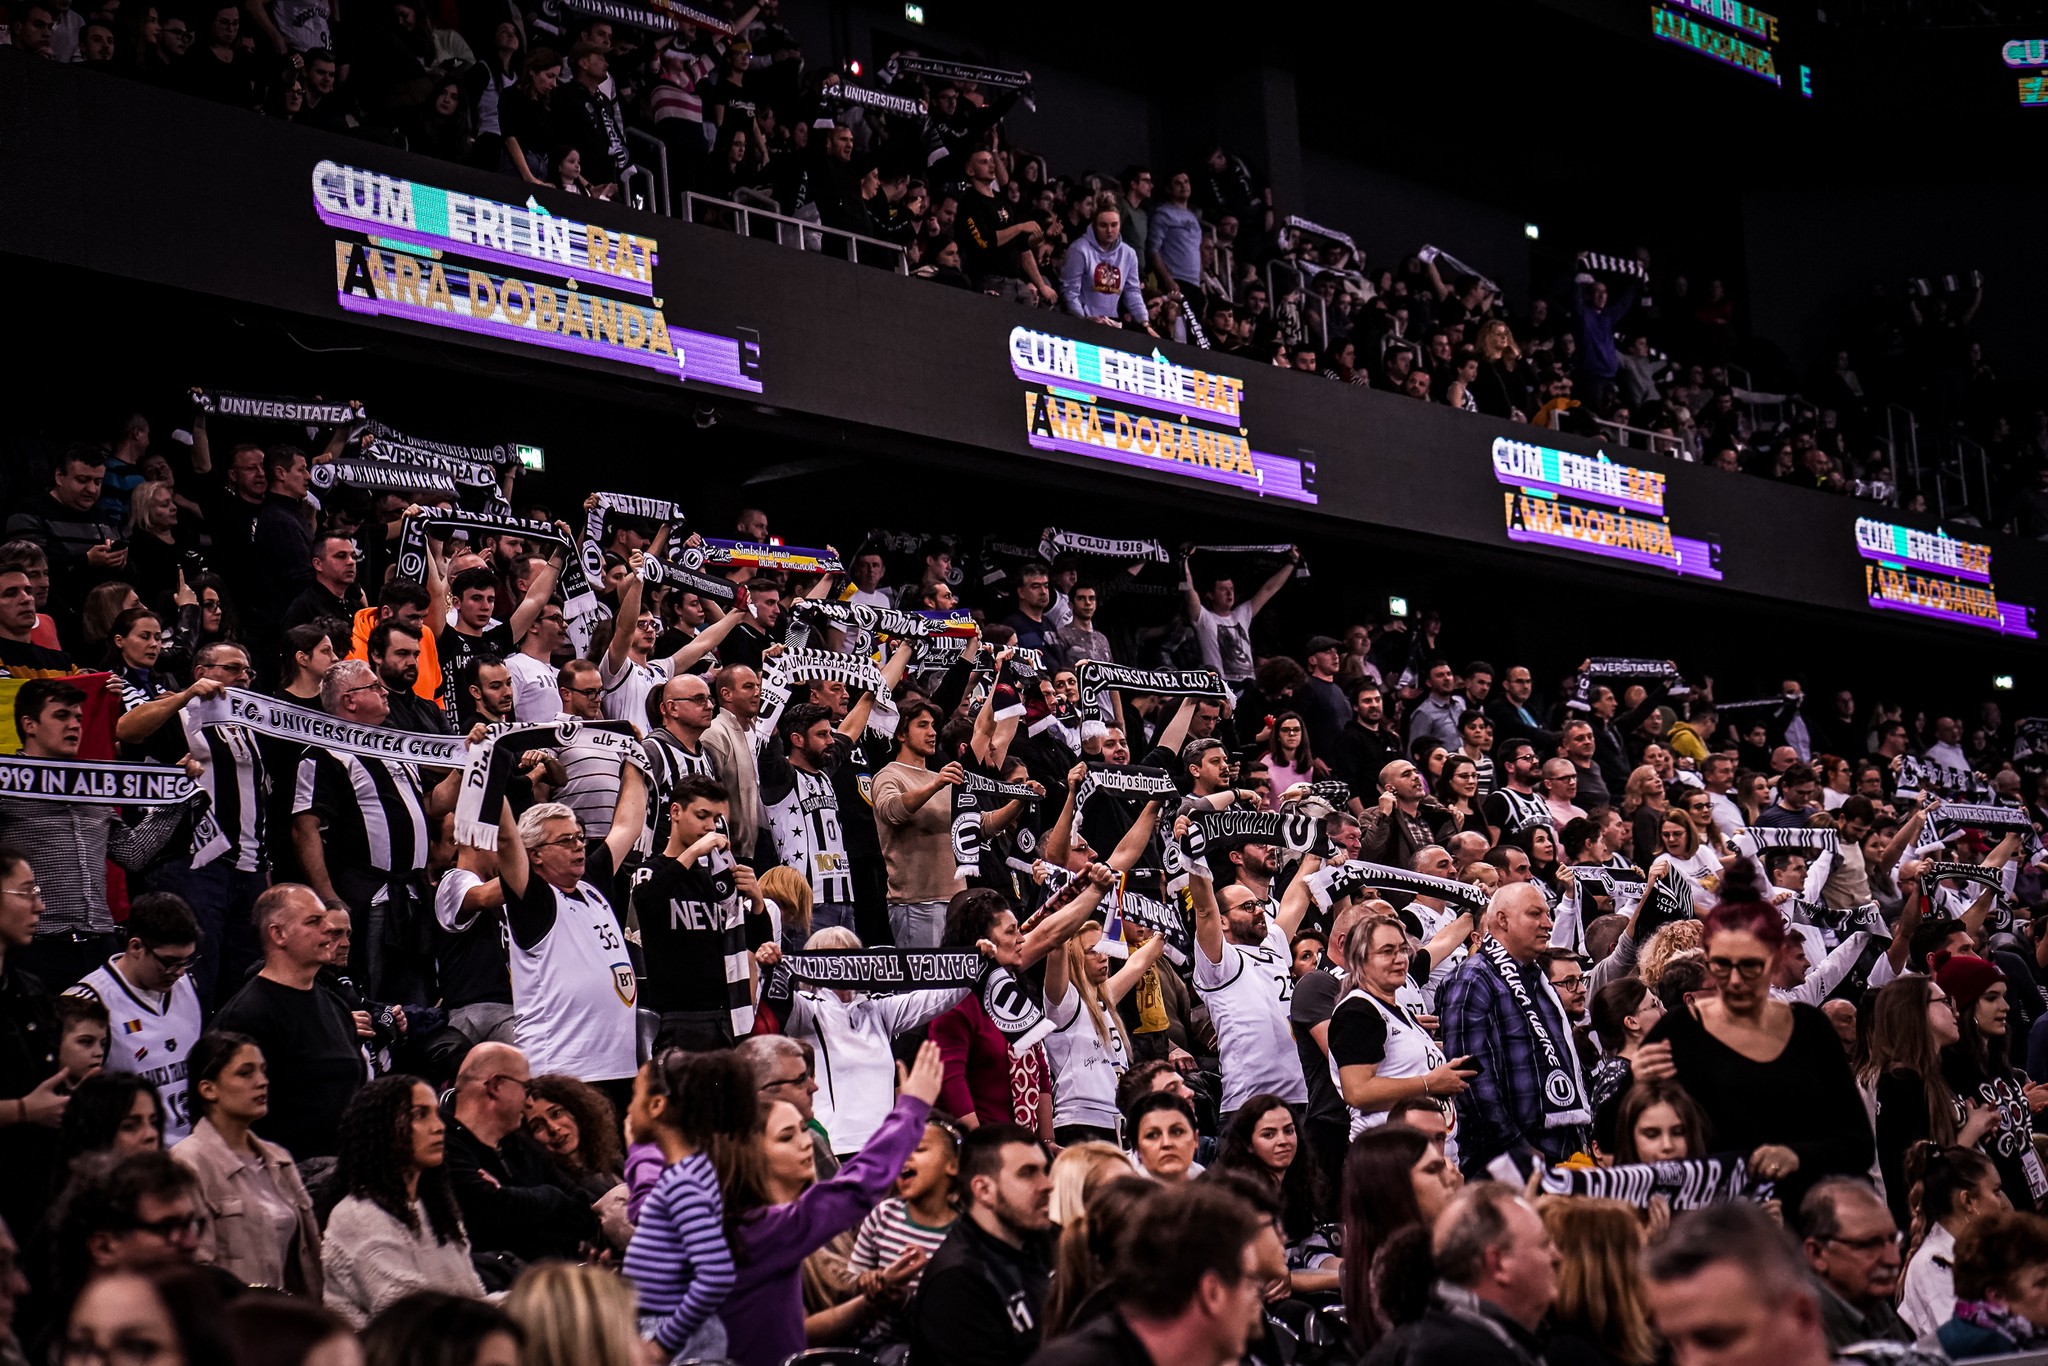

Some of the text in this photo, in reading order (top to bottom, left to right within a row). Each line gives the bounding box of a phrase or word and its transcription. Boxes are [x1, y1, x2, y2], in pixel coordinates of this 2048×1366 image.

[844, 86, 918, 115] UNIVERSITATEA
[219, 396, 354, 423] UNIVERSITATEA
[407, 434, 471, 461] UNIVERSITATEA
[471, 447, 493, 462] CLUJ
[350, 465, 438, 490] UNIVERSITATEA
[1064, 534, 1143, 552] U CLUJ 1919
[791, 655, 861, 673] UNIVERSITATEA
[1181, 673, 1210, 689] CLUJ
[230, 698, 456, 760] F.C. UNIVERSITATEA CLUJ
[592, 733, 617, 747] alb
[0, 766, 36, 791] 919
[41, 769, 66, 793] IN
[72, 771, 117, 796] ALB
[122, 773, 141, 797] SI
[468, 748, 491, 789] Din
[1948, 806, 2014, 823] UNIVERSITATEA
[1204, 810, 1281, 841] NUMAI
[1282, 813, 1319, 854] U
[1660, 897, 1679, 910] CLUJ
[593, 923, 621, 951] 35
[618, 972, 635, 988] BT
[907, 953, 980, 981] BANCA
[1484, 938, 1562, 1068] SINGURA IUBIRE
